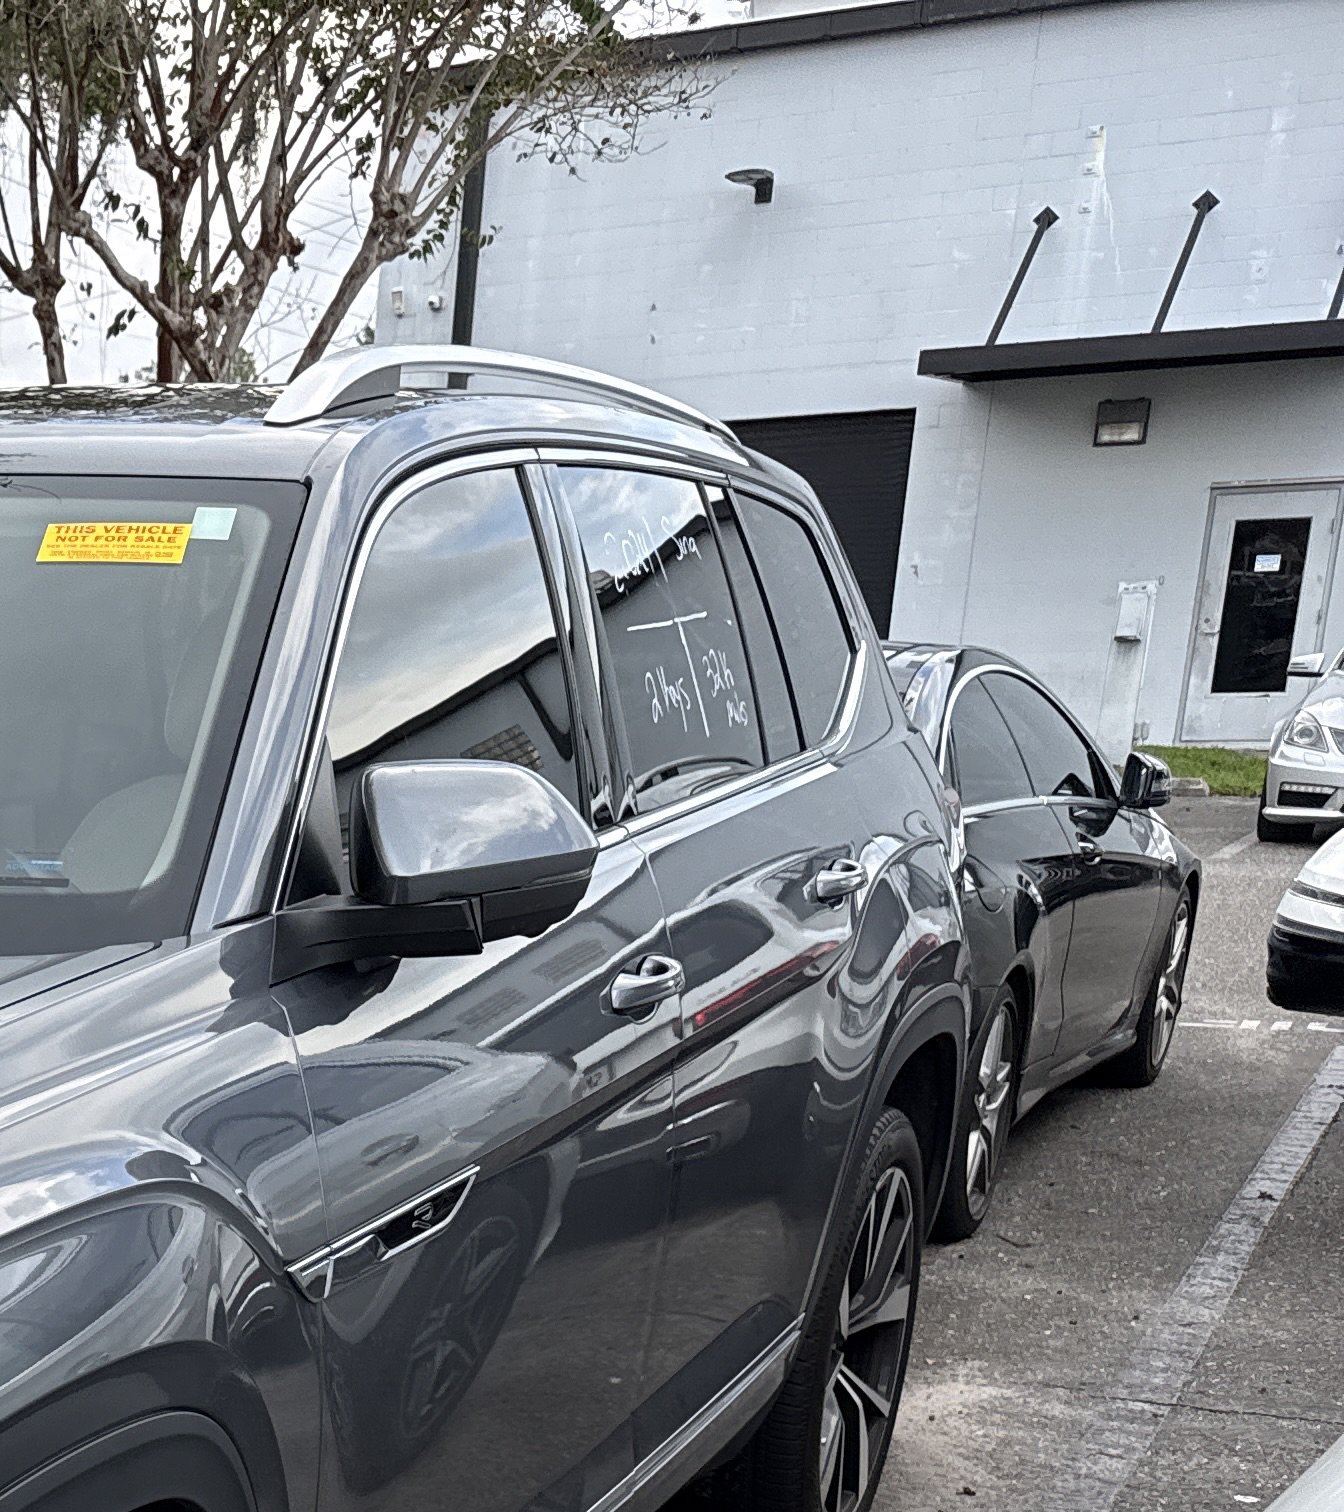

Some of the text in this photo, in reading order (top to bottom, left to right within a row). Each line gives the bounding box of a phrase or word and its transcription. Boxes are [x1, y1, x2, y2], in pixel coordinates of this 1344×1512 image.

[55, 525, 186, 535] THIS VEHICLE
[55, 535, 178, 544] NOT FOR SALE
[645, 672, 664, 724] 2
